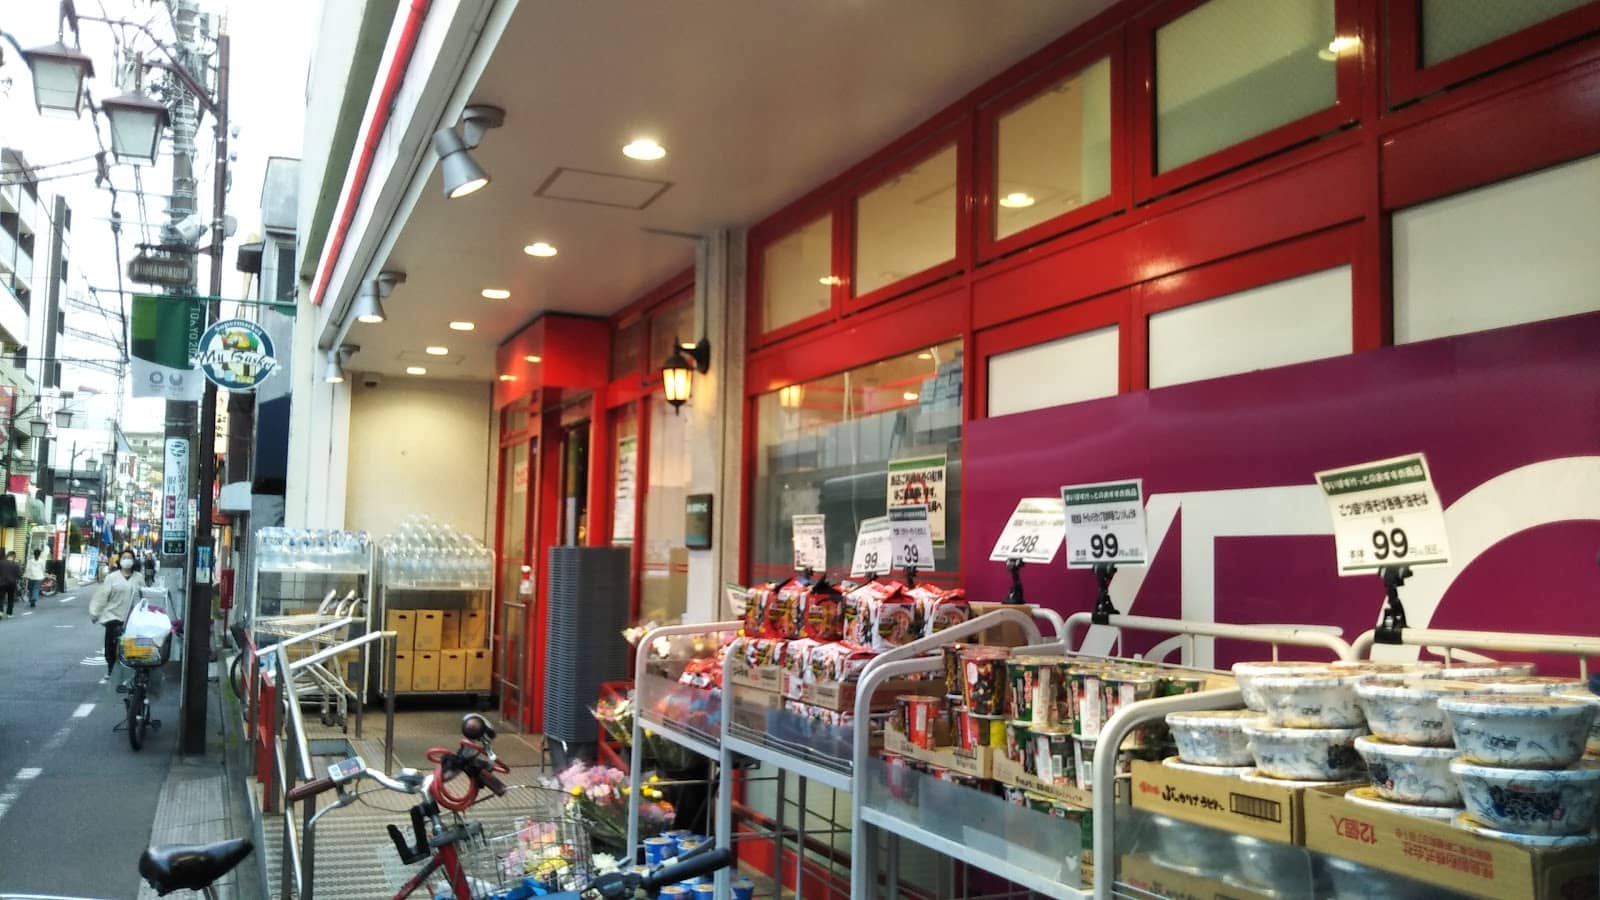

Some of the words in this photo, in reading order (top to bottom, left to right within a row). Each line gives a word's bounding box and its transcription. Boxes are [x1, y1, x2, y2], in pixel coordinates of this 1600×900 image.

[189, 307, 200, 340] TOKYO
[215, 321, 262, 336] Supermarket
[194, 350, 224, 367] My
[231, 351, 277, 372] Basket
[903, 544, 919, 564] 39
[1011, 535, 1040, 553] 298
[1090, 533, 1119, 559] 99
[1372, 528, 1409, 561] 99
[864, 551, 879, 570] 99
[1330, 814, 1377, 845] 12個入
